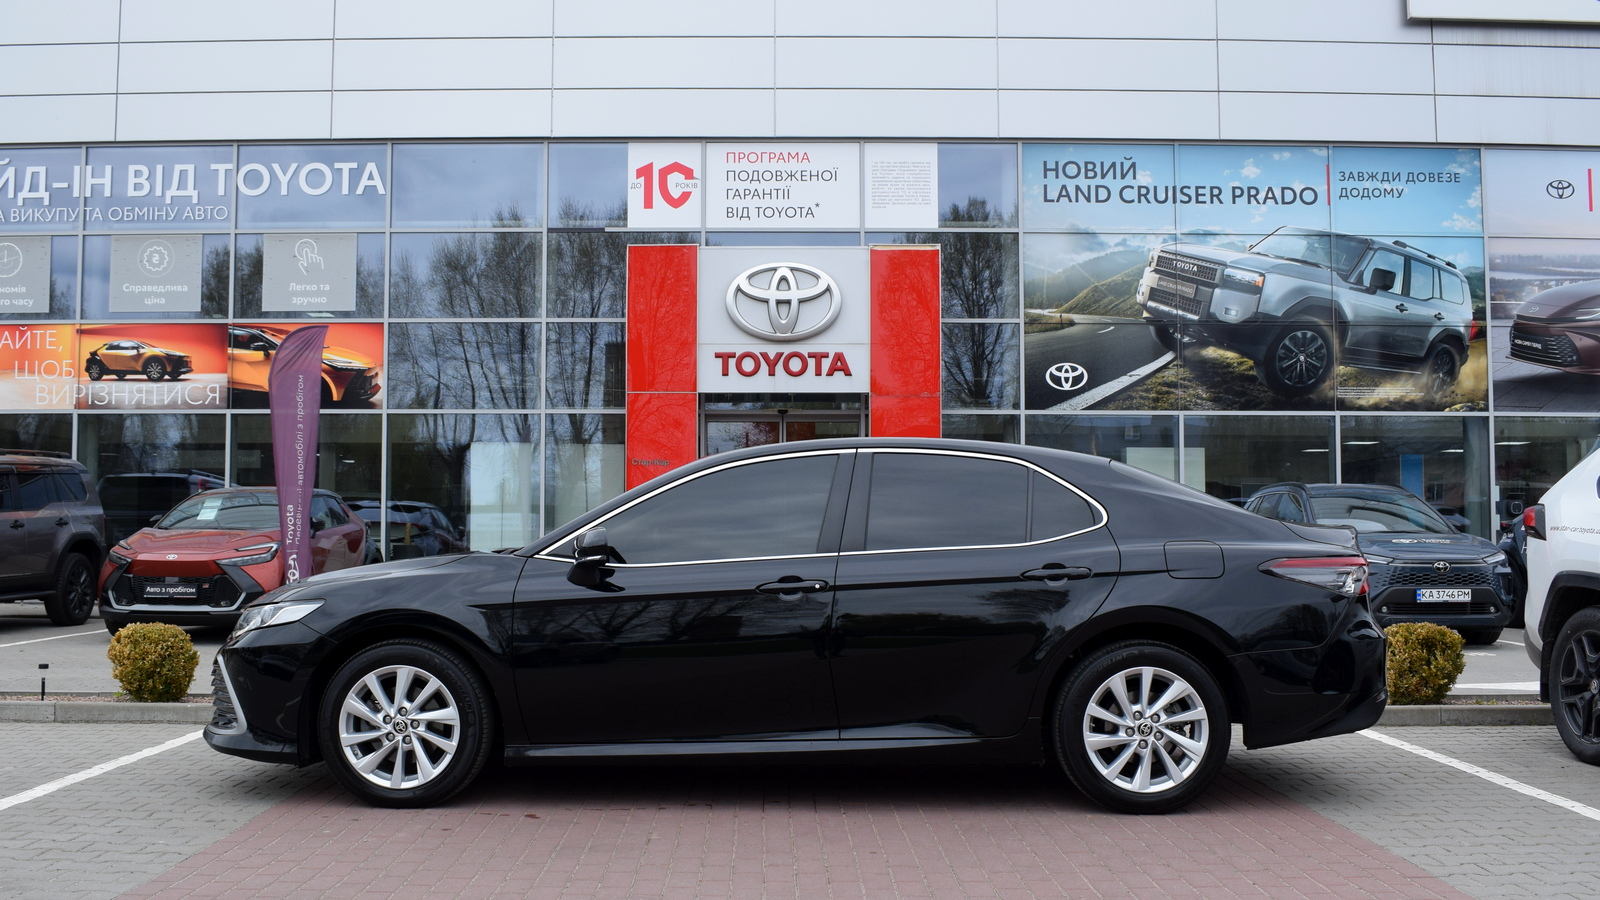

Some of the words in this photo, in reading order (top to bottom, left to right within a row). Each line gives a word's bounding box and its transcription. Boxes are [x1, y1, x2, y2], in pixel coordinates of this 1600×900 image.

[726, 151, 811, 164] ПРОГРАМА
[1042, 156, 1137, 180] НОВИЙ
[726, 167, 839, 184] ПОДОВЖЕНОЇ
[1338, 171, 1401, 184] ЗАВЖДИ
[1405, 172, 1461, 184] ДОВЕЗЕ
[127, 164, 199, 204] ВІД
[210, 162, 386, 196] TOYOTA
[630, 182, 642, 190] ДО
[726, 185, 791, 200] ГАРАНТІЇ
[1043, 184, 1112, 203] LAND
[1118, 185, 1224, 205] CRUISER
[1231, 186, 1319, 206] PRADO
[1338, 187, 1404, 201] ДОДОМУ
[11, 208, 79, 222] ВИКУПУ
[84, 207, 103, 221] ТА
[108, 206, 178, 221] ОБМІНУ
[183, 206, 229, 220] АВТО
[726, 207, 751, 221] ВІД
[1173, 261, 1198, 272] TOYOTA
[123, 283, 188, 293] Справедлива
[289, 283, 317, 291] Легко
[12, 299, 34, 307] часу
[144, 296, 166, 305] ціна
[292, 296, 327, 305] зручно
[714, 351, 853, 377] TOYOTA
[15, 360, 75, 382] ЩОБ
[36, 384, 220, 405] ВИРІЗНЯТИСЯ
[296, 375, 304, 421] пробігом
[631, 458, 670, 467] Стар-Кар
[166, 586, 196, 594] пробігом
[1421, 590, 1434, 599] KA
[1436, 590, 1456, 599] 3746
[1457, 590, 1470, 599] PM
